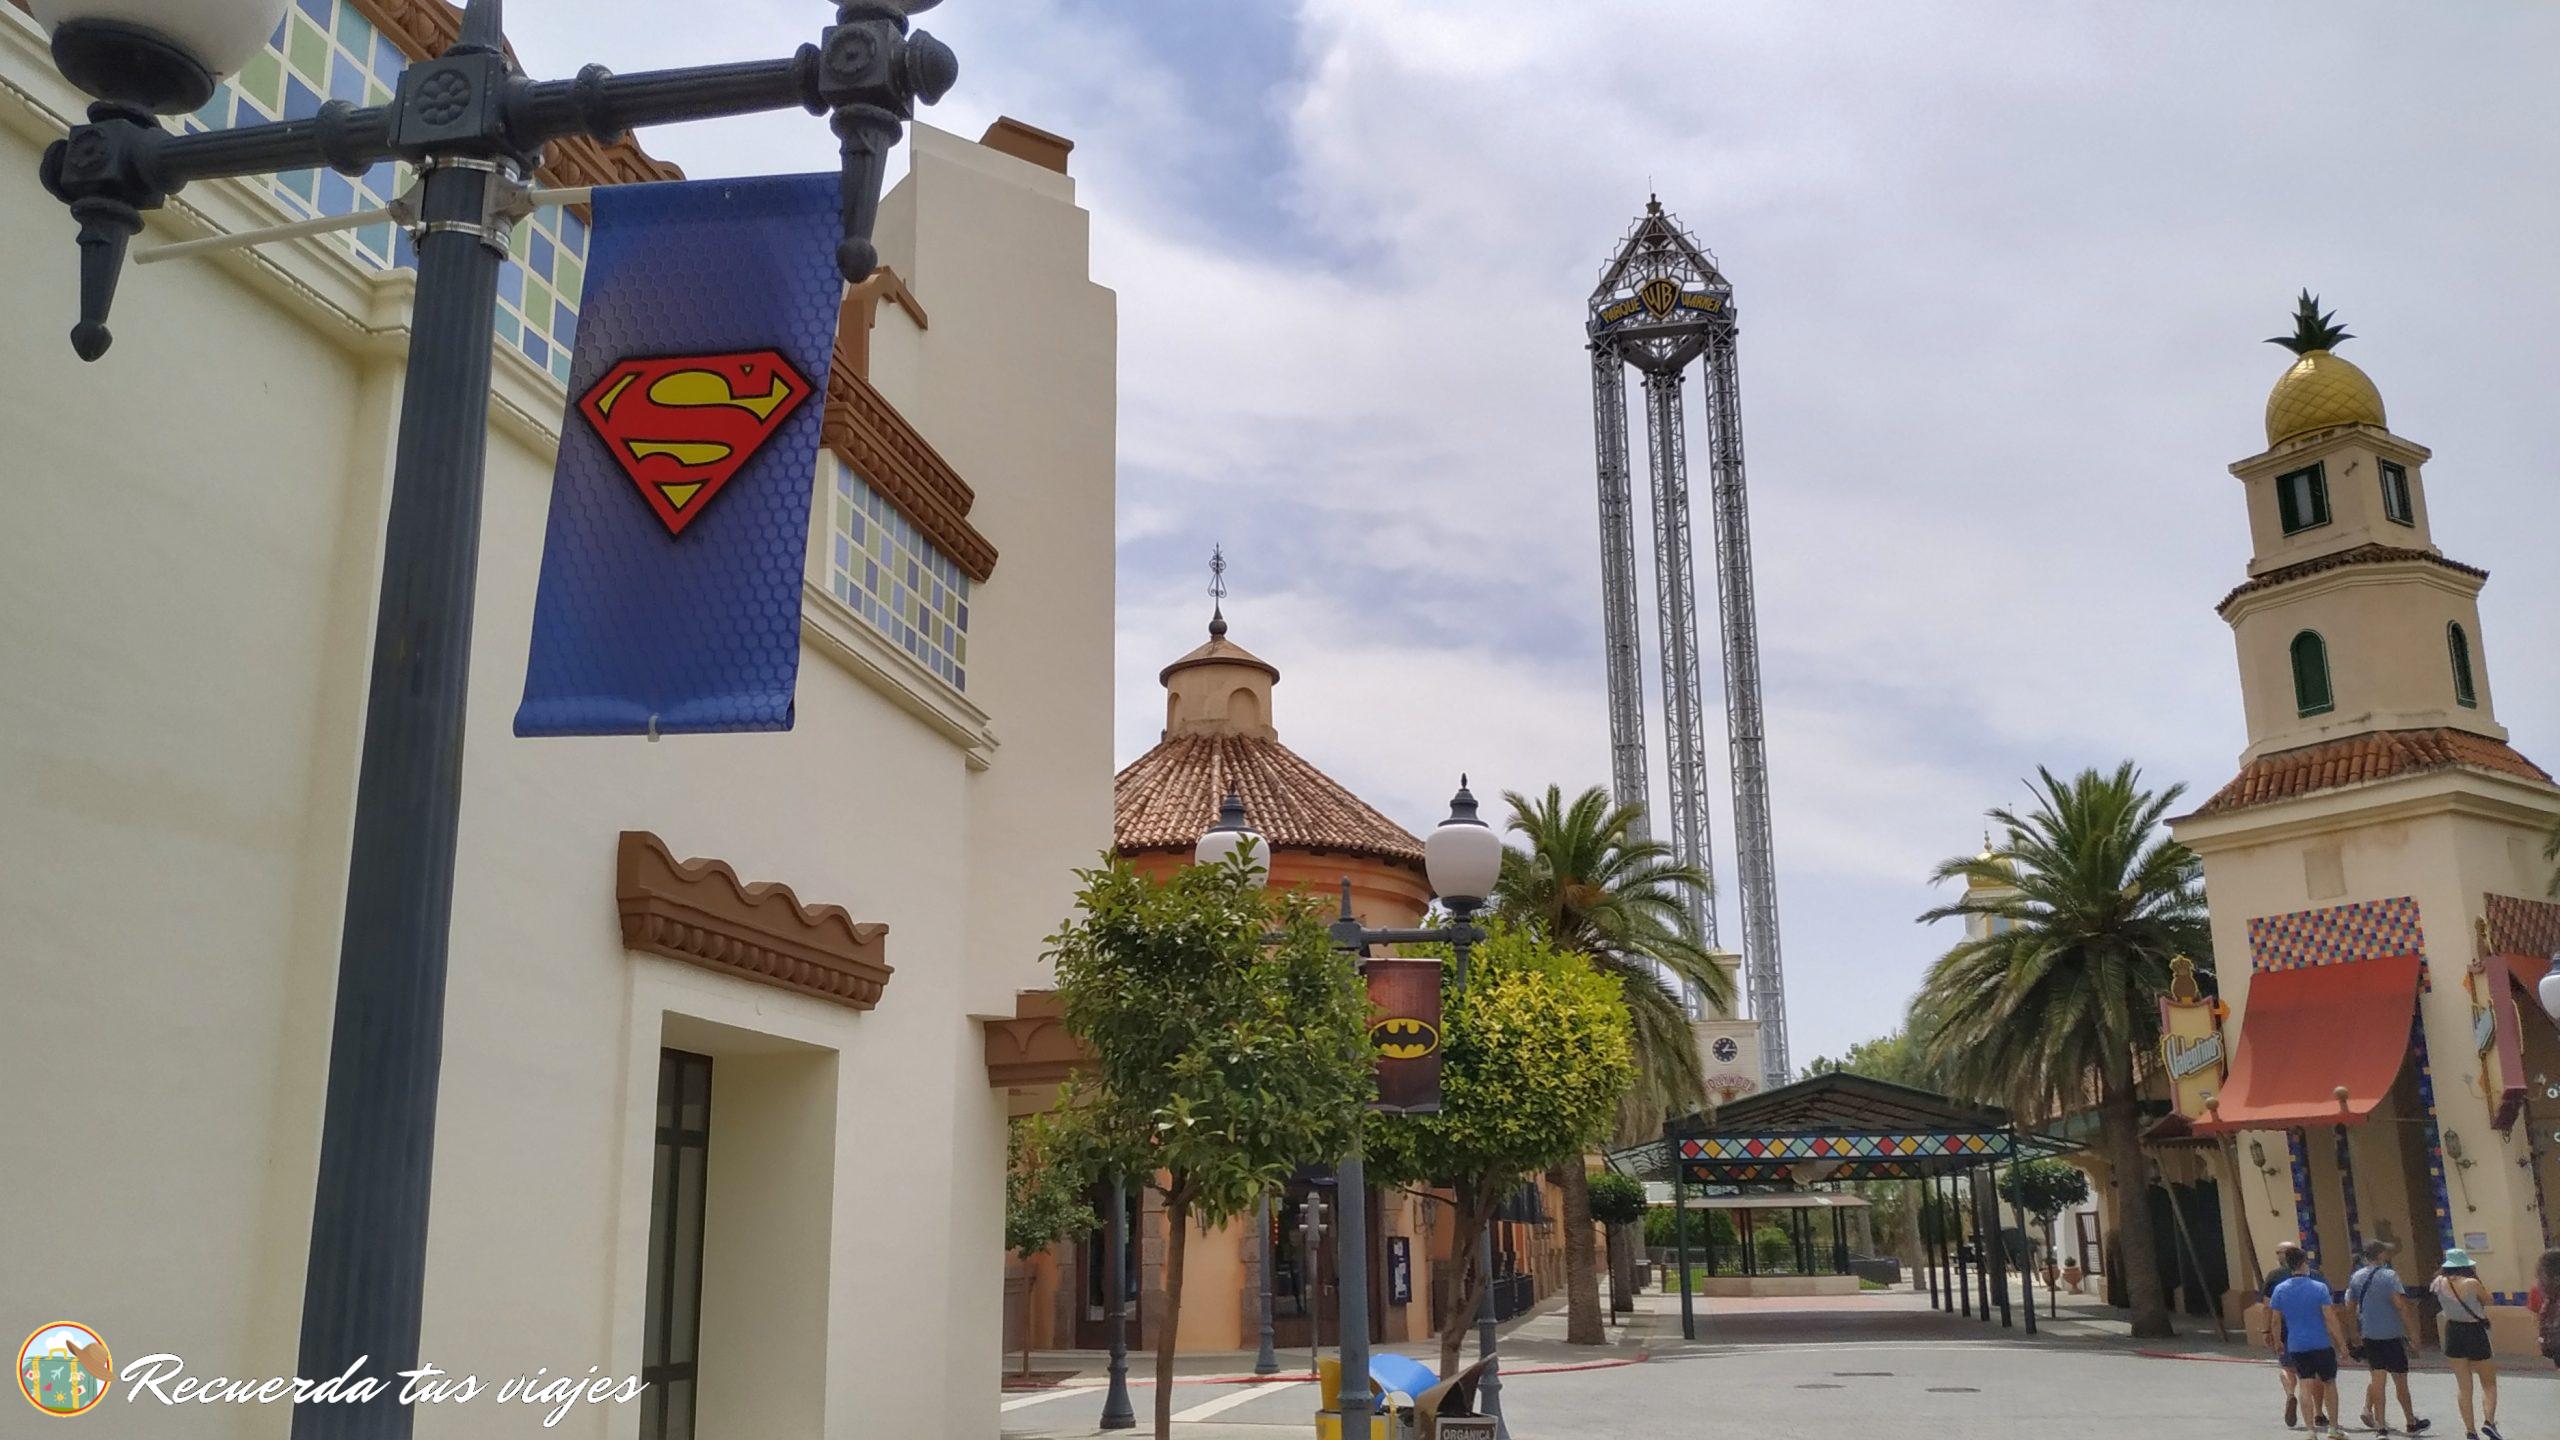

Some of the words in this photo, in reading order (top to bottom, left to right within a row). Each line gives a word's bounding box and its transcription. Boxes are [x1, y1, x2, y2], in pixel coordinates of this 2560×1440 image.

[1601, 296, 1642, 324] PARQUE
[1681, 291, 1722, 314] WARNER
[1644, 280, 1673, 313] WB
